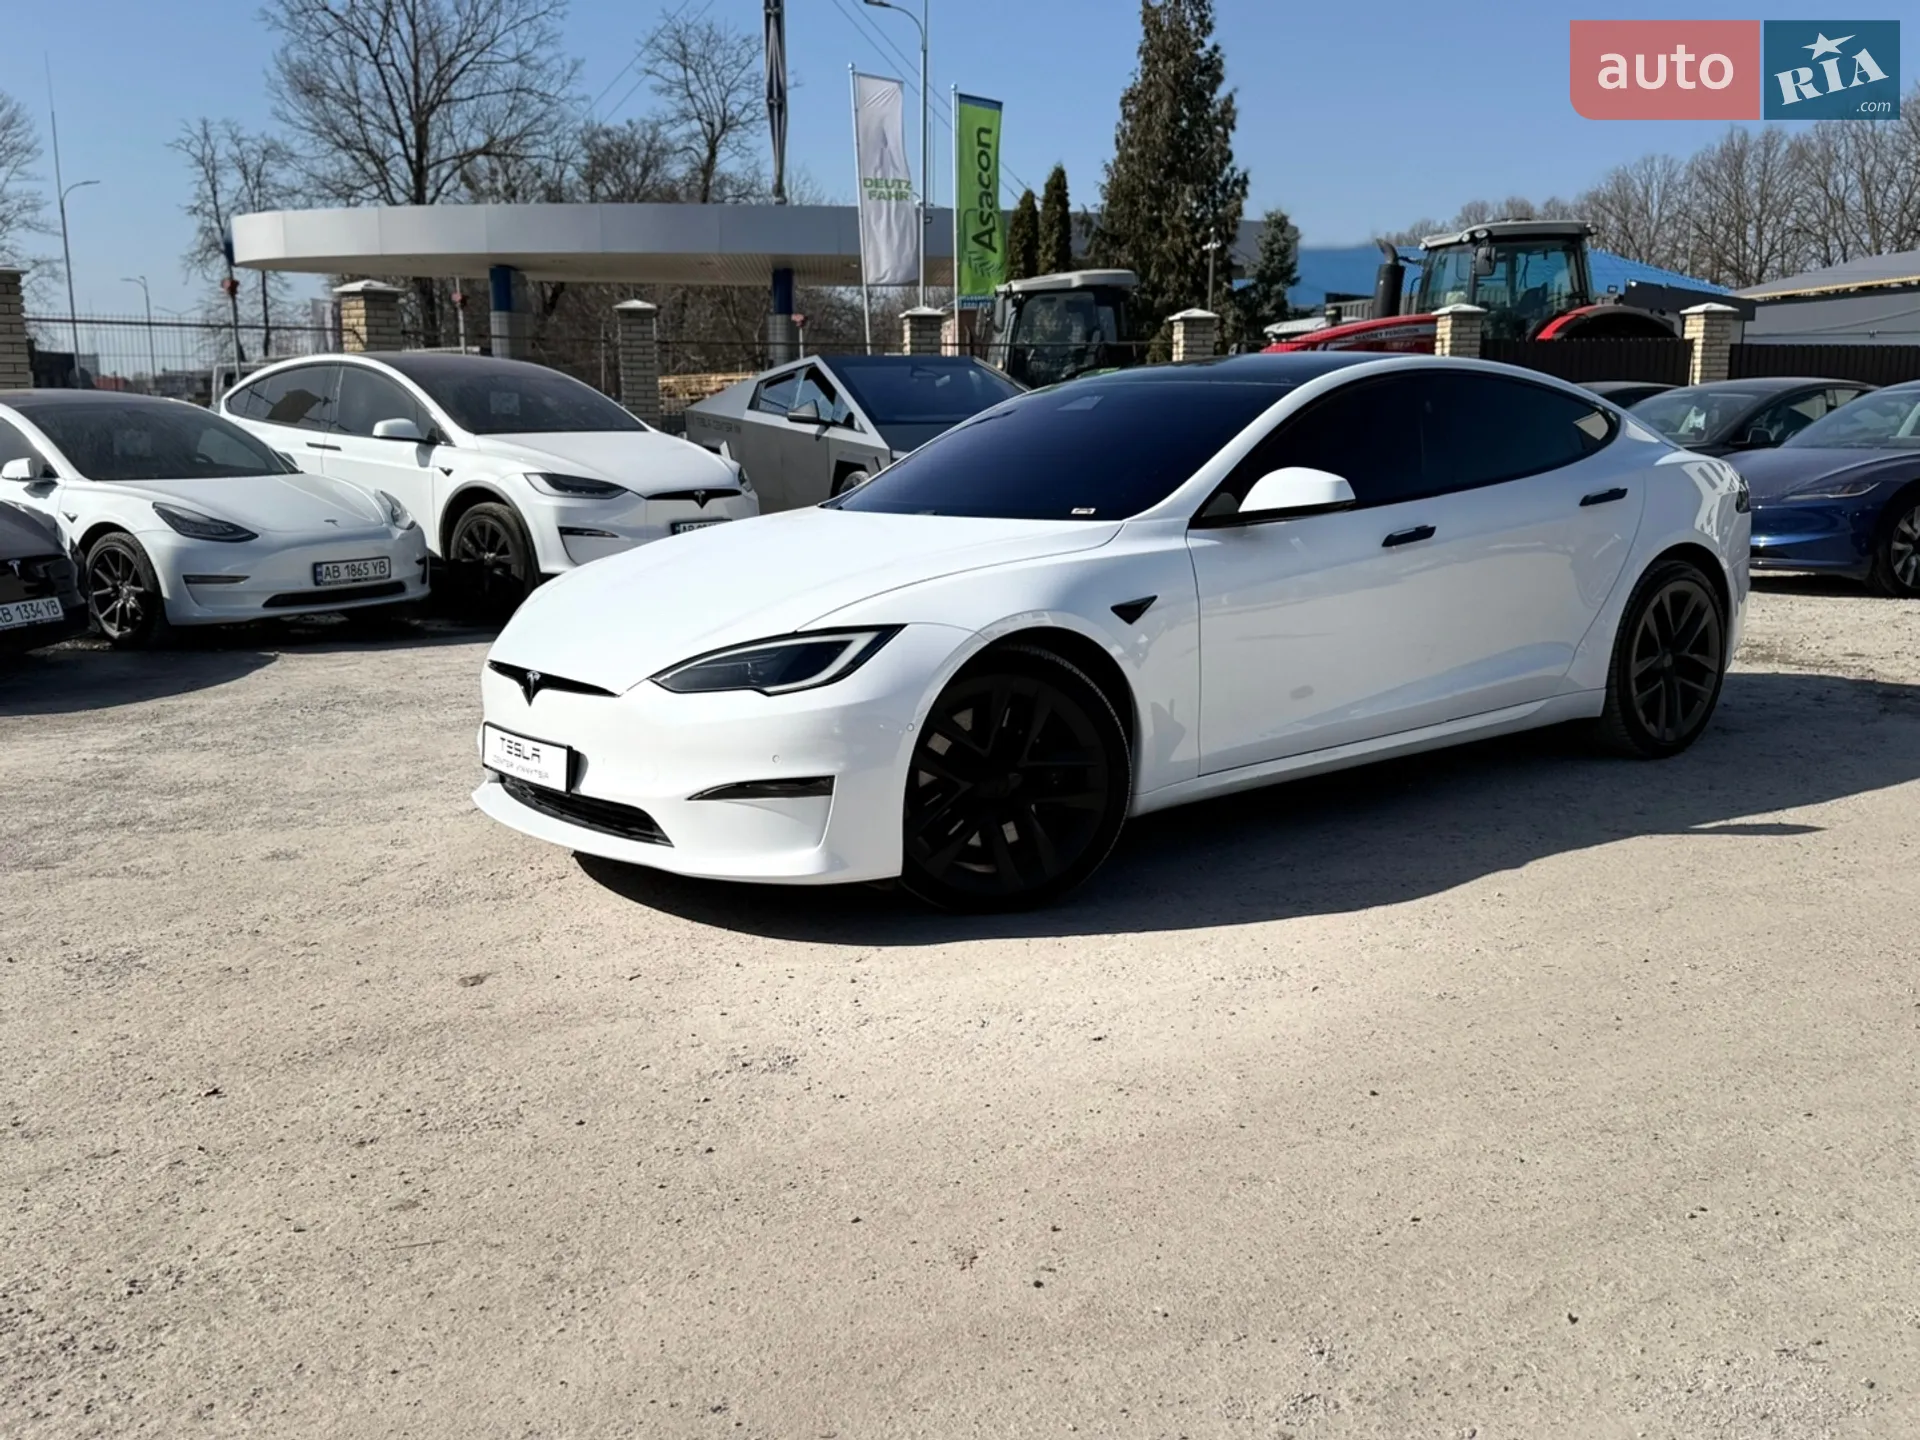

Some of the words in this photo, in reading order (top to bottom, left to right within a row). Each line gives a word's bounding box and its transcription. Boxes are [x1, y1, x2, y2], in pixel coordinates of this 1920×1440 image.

[863, 178, 912, 191] DEUTZ
[971, 126, 998, 254] Asacon
[868, 190, 909, 201] FAHR
[324, 565, 341, 579] AB
[344, 562, 369, 577] 1865
[372, 560, 387, 575] YB
[15, 602, 44, 620] 1334
[43, 600, 60, 616] YB
[500, 736, 541, 764] TESLA
